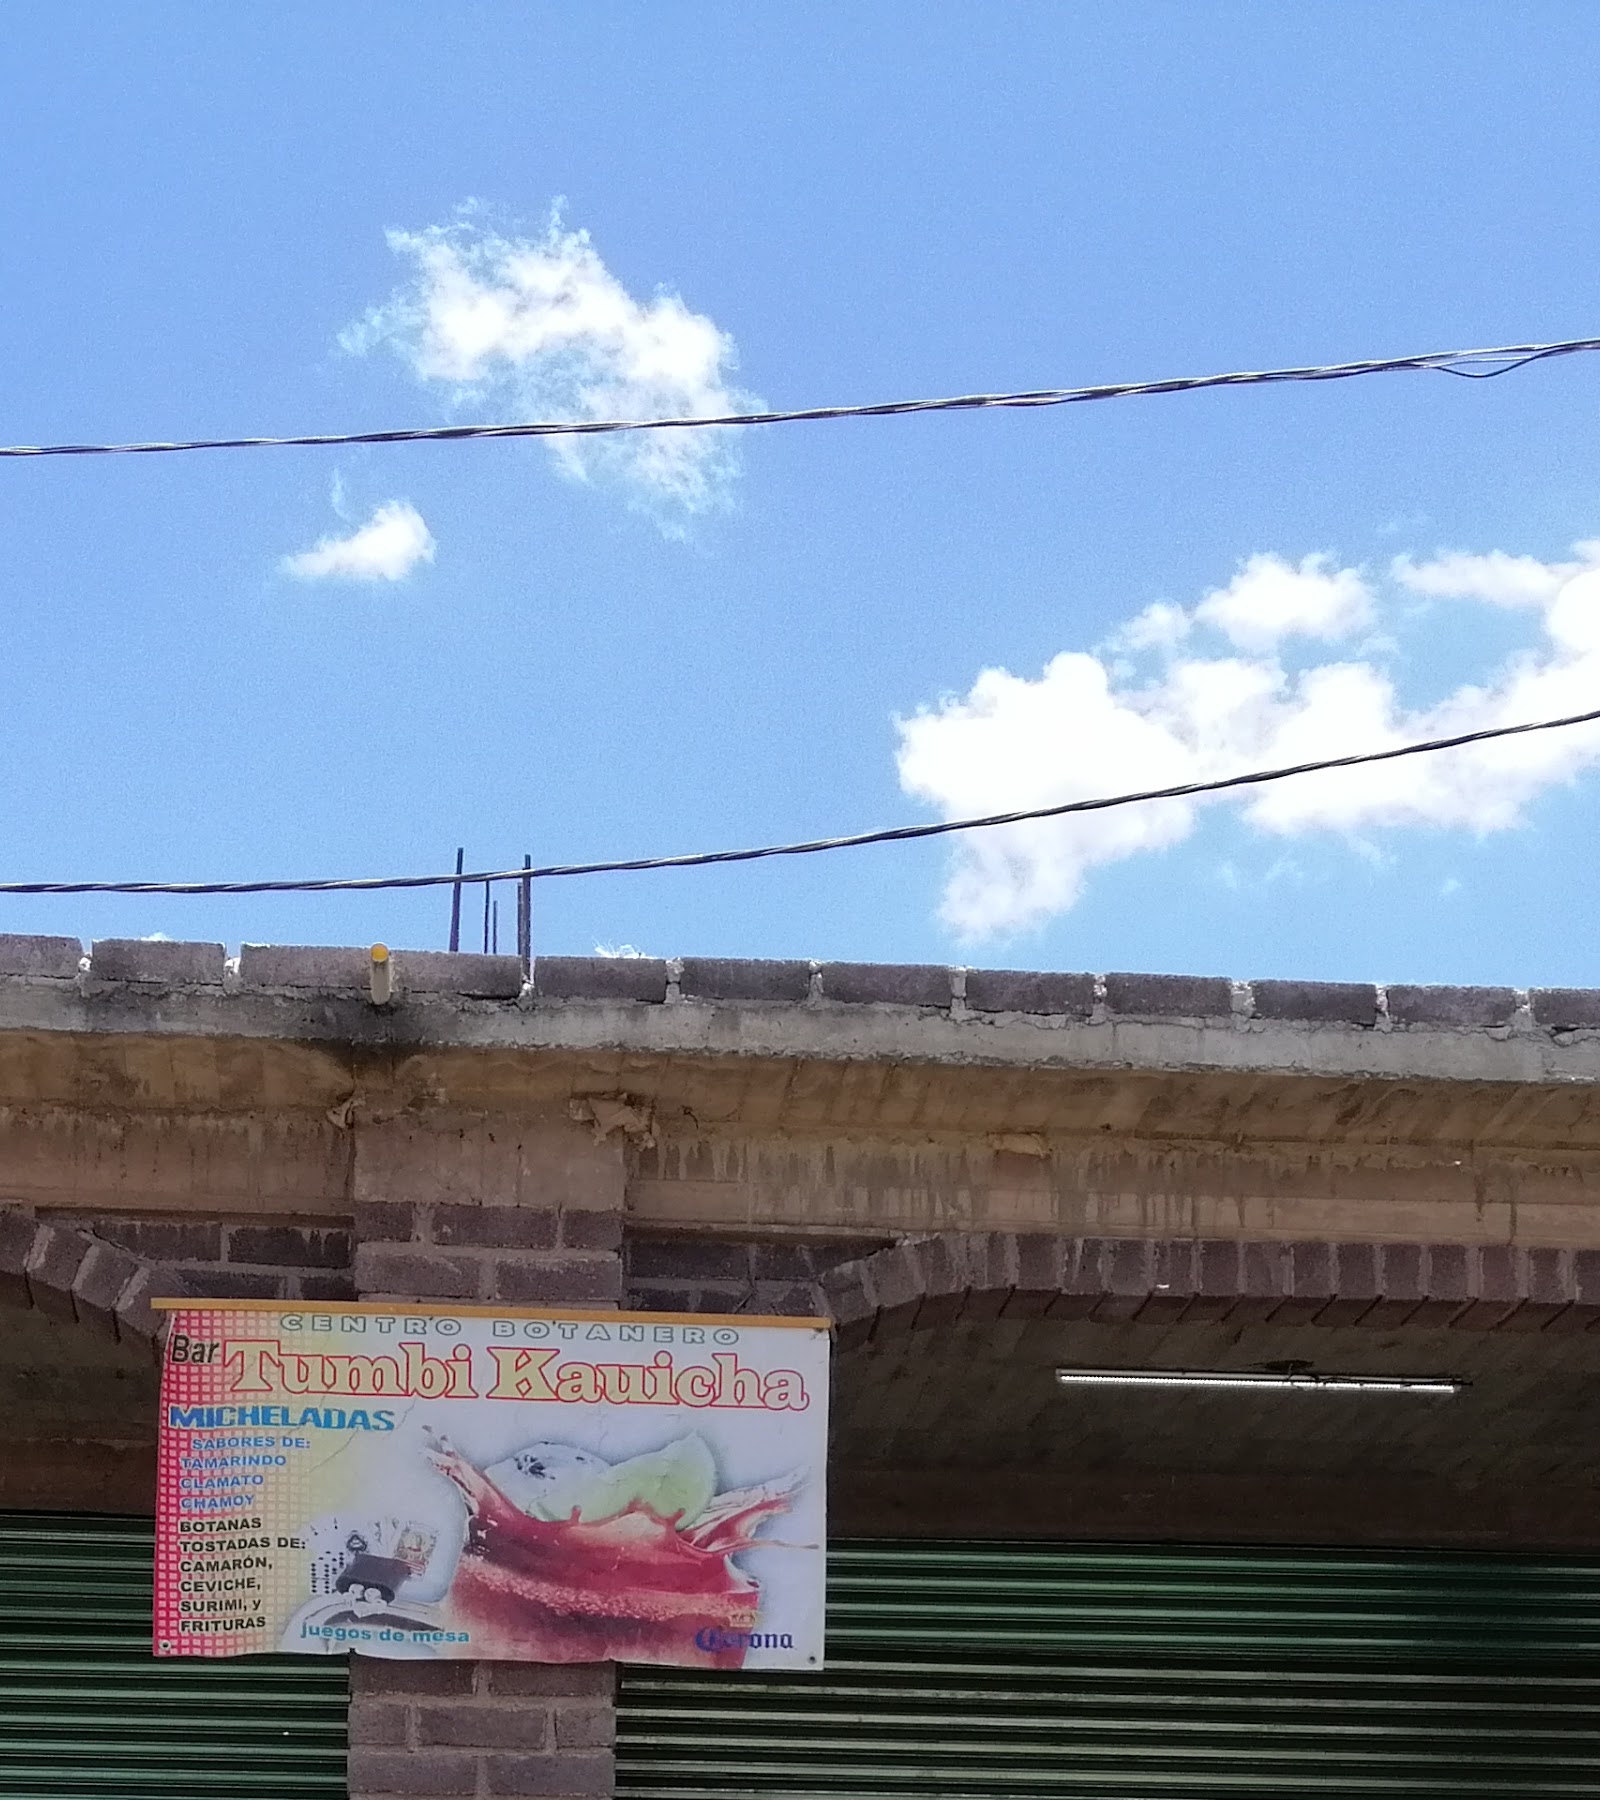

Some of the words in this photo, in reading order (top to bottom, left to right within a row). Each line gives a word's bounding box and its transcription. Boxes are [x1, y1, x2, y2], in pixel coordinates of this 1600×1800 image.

[280, 1314, 461, 1336] CENTRO
[493, 1321, 739, 1345] BOTANERO
[172, 1335, 218, 1363] Bar
[224, 1340, 479, 1398] Tumbi
[486, 1347, 810, 1411] Kauicha
[169, 1405, 396, 1431] MICHELADAS
[192, 1436, 275, 1449] SABORES
[282, 1437, 311, 1448] DE:
[181, 1455, 286, 1468] TAMARINDO
[181, 1474, 264, 1489] CLAMATO
[181, 1494, 254, 1509] CHAMOY
[180, 1517, 262, 1532] BOTANAS
[180, 1537, 271, 1552] TOSTADAS
[277, 1537, 306, 1549] DE:
[180, 1557, 273, 1572] CAMARÓN,
[180, 1577, 261, 1592] CEVICHE,
[180, 1599, 247, 1612] SURIMI,
[252, 1600, 261, 1611] y
[180, 1616, 266, 1632] FRITURAS
[301, 1622, 372, 1641] juegos
[379, 1629, 404, 1642] de
[413, 1630, 470, 1643] mesa
